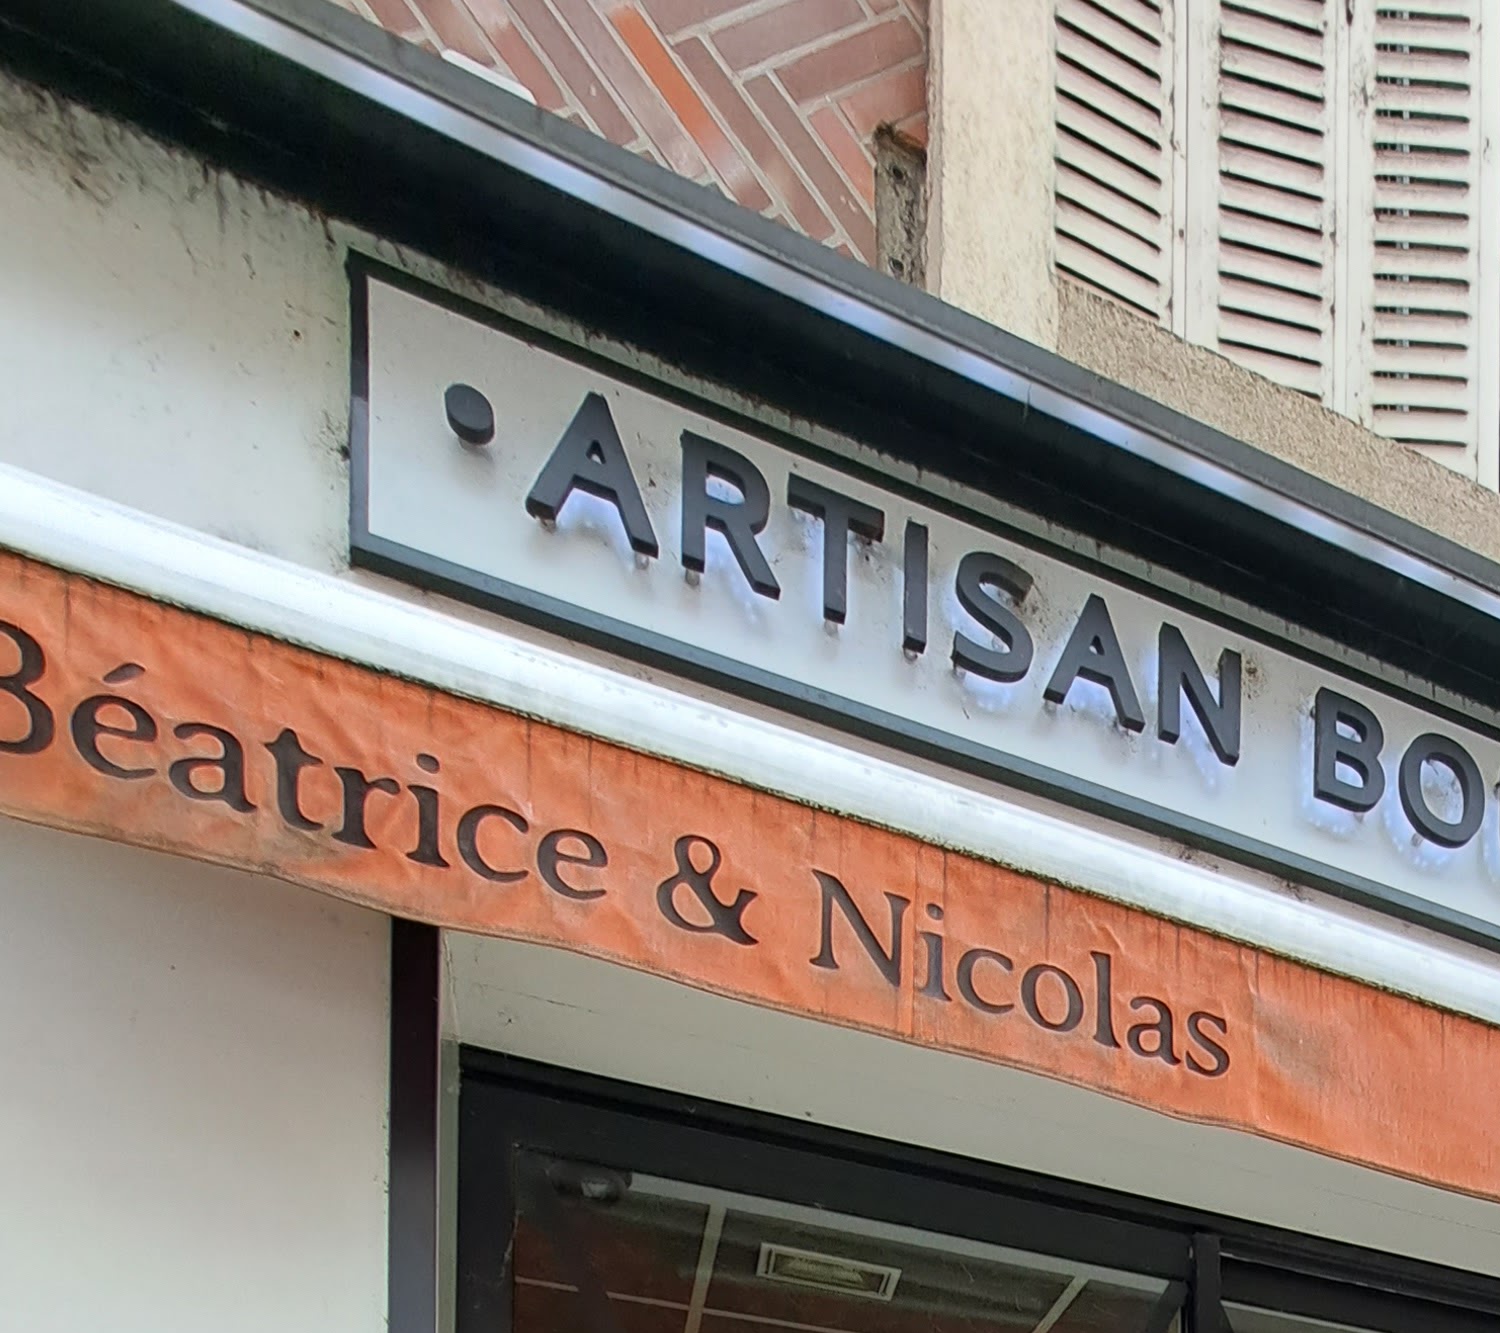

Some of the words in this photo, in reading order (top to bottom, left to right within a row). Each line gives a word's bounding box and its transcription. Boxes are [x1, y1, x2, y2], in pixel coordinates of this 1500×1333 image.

[525, 392, 1243, 767] ARTISAN
[0, 618, 608, 899] Béatrice
[656, 835, 759, 946] &
[810, 869, 1231, 1077] Nicolas
